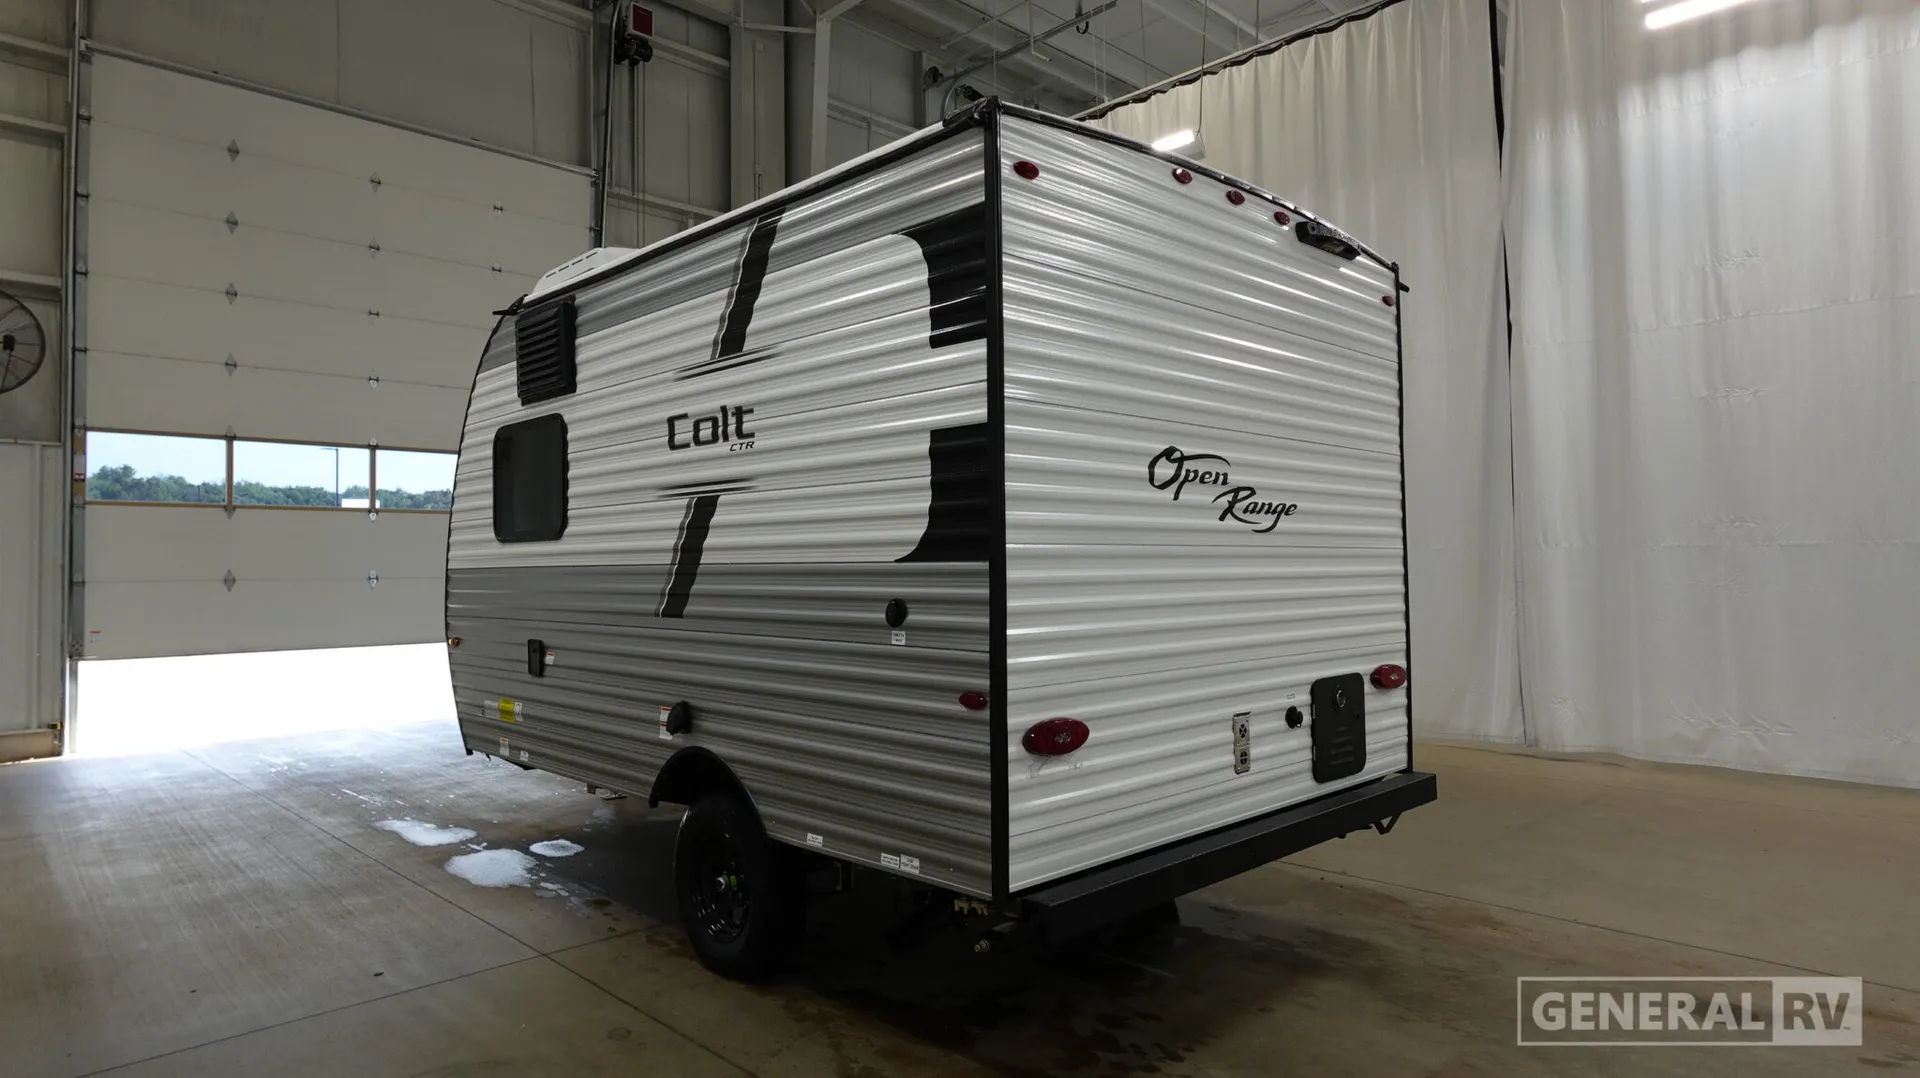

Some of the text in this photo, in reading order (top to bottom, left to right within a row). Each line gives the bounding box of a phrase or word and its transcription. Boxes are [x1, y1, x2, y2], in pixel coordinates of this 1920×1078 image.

[667, 405, 755, 451] Colt
[729, 441, 755, 452] CTR
[1148, 446, 1231, 501] Open
[1212, 486, 1298, 533] Range
